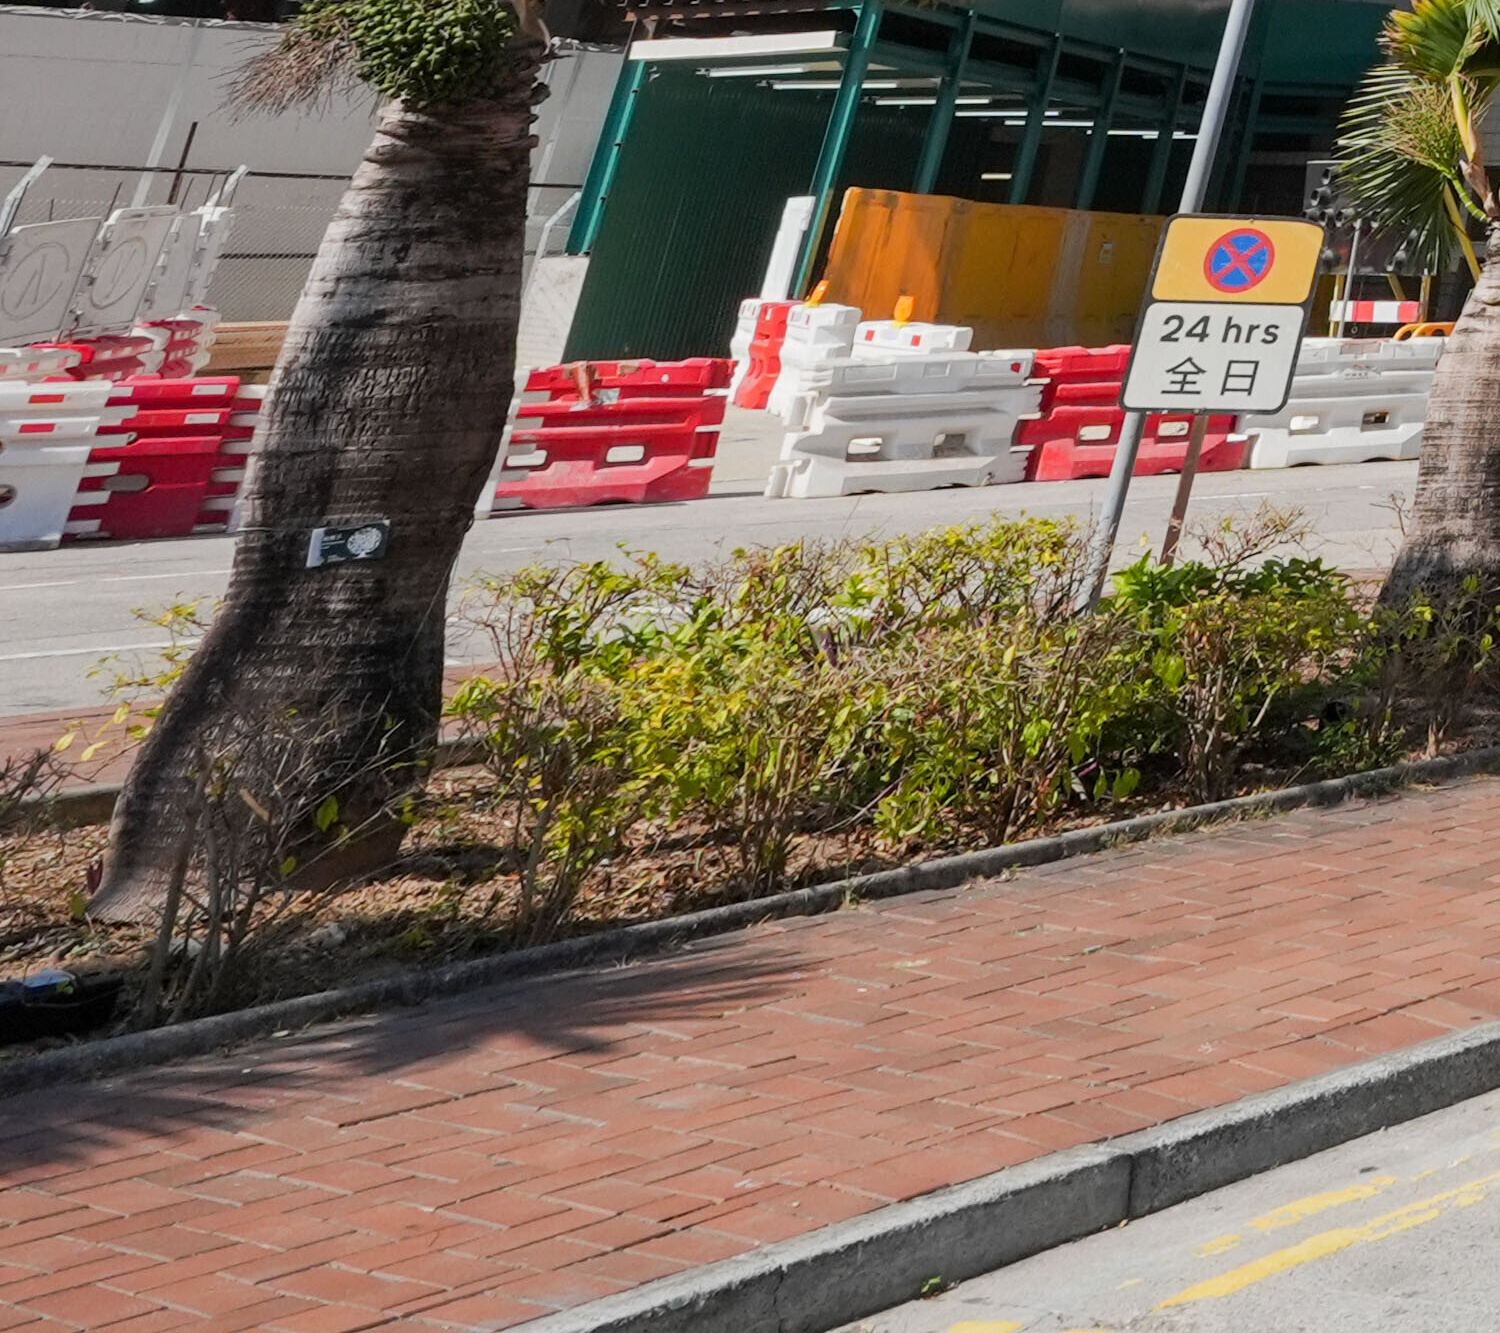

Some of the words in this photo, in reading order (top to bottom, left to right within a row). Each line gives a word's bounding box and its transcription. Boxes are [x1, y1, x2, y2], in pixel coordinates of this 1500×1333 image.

[1159, 315, 1210, 343] 24
[1222, 315, 1279, 345] hrs
[1160, 356, 1260, 397] 全日
